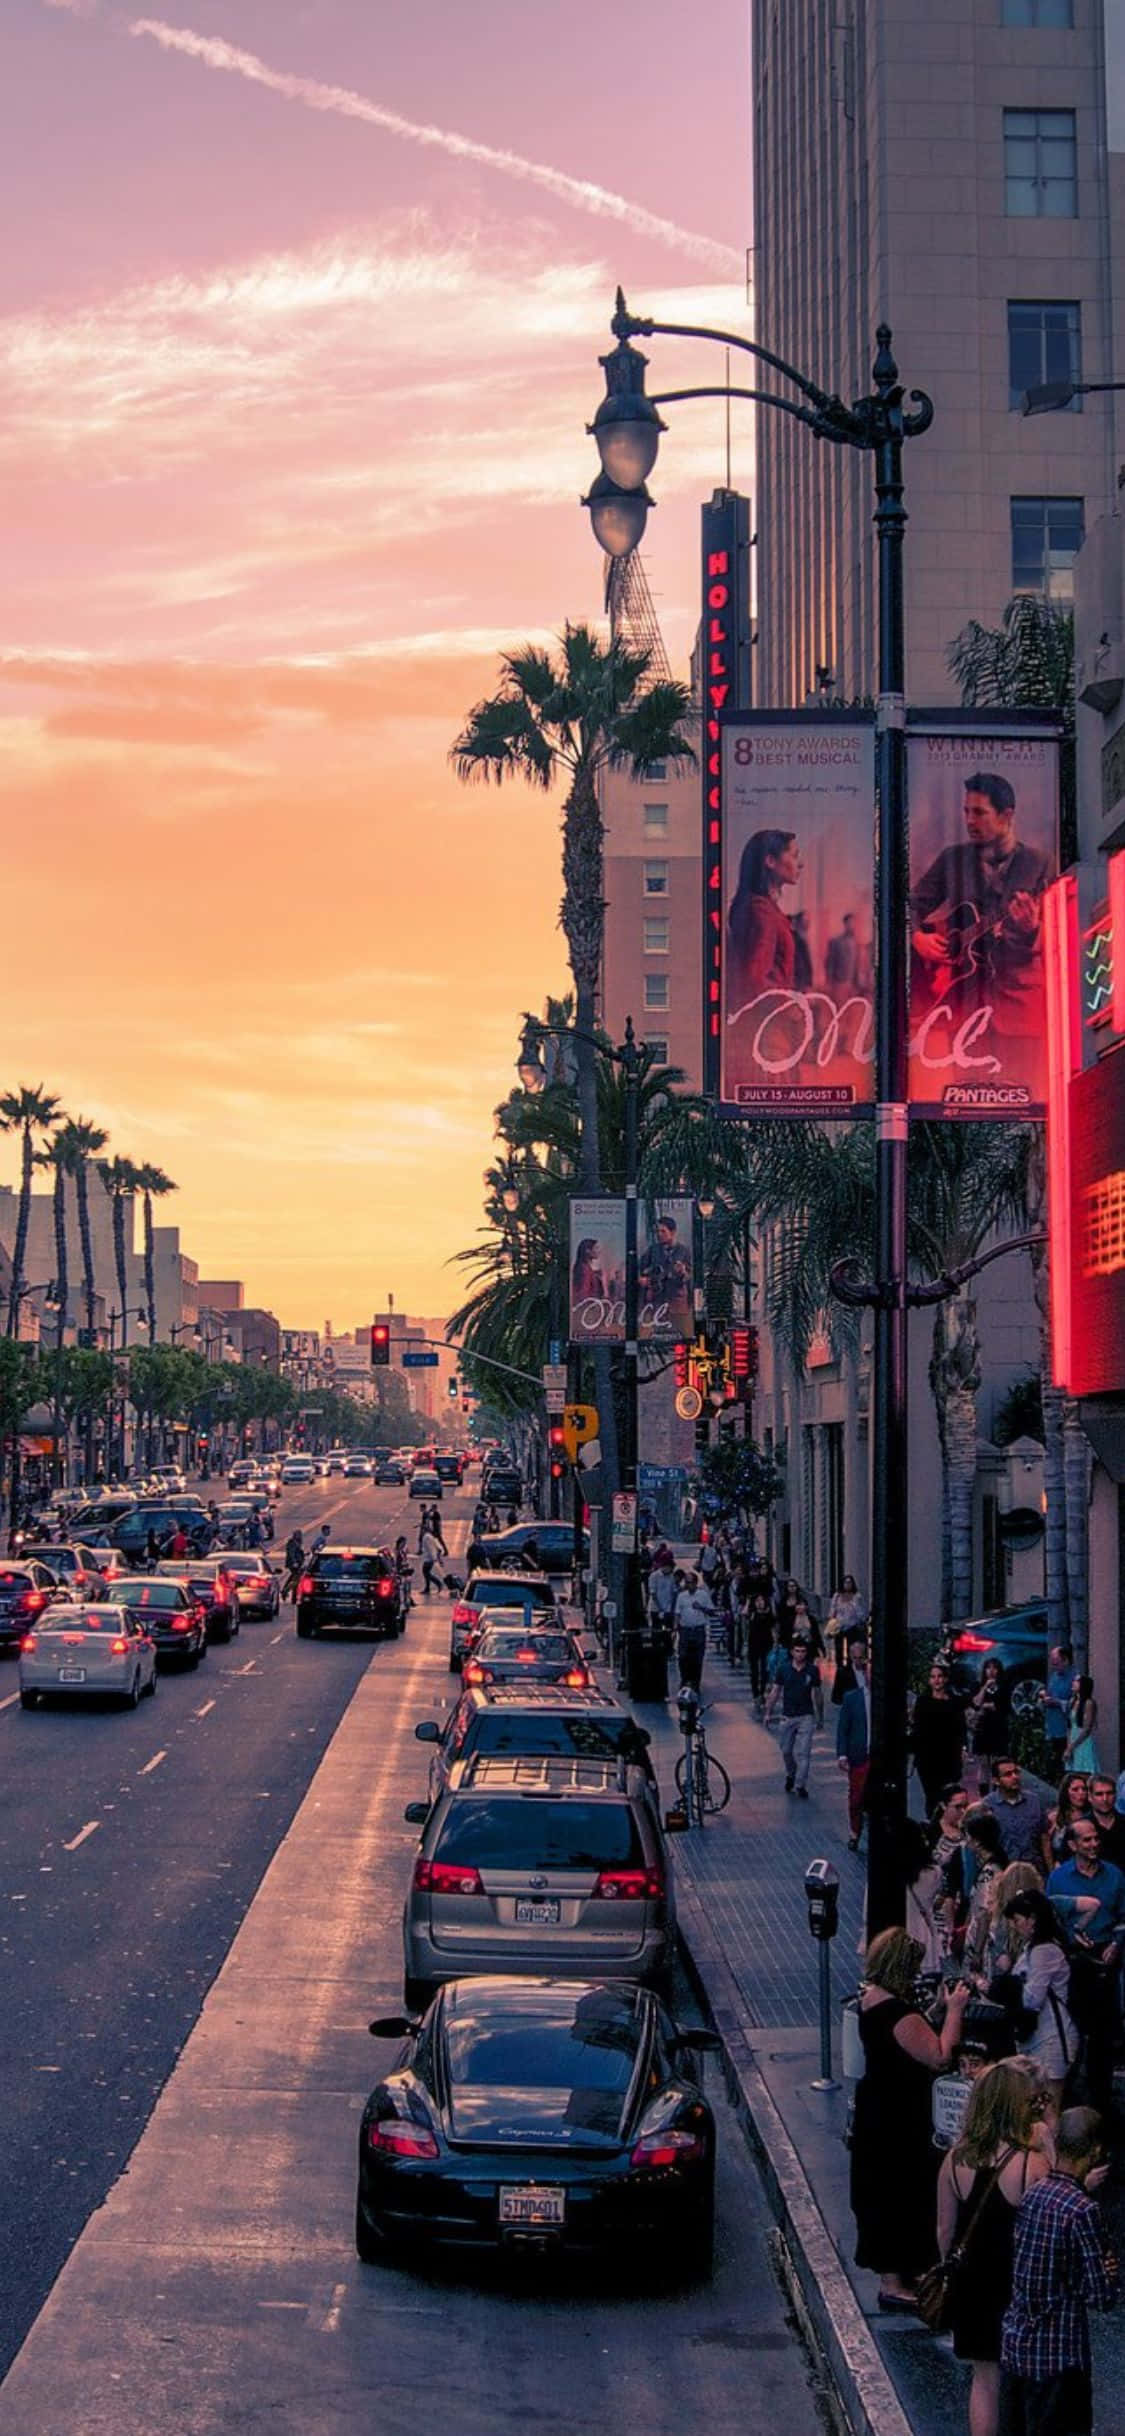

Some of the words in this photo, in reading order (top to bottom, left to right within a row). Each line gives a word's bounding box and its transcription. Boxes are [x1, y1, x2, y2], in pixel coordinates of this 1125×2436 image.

[734, 738, 753, 765] 8
[754, 738, 793, 750] TONY
[797, 737, 861, 750] AWARDS
[755, 753, 792, 765] BEST
[798, 752, 861, 765] MUSICAL
[744, 1090, 768, 1100] JULY
[771, 1090, 782, 1100] 15
[789, 1090, 832, 1100] AUGUST
[836, 1090, 847, 1100] 10
[944, 1087, 1029, 1102] PANTAGES
